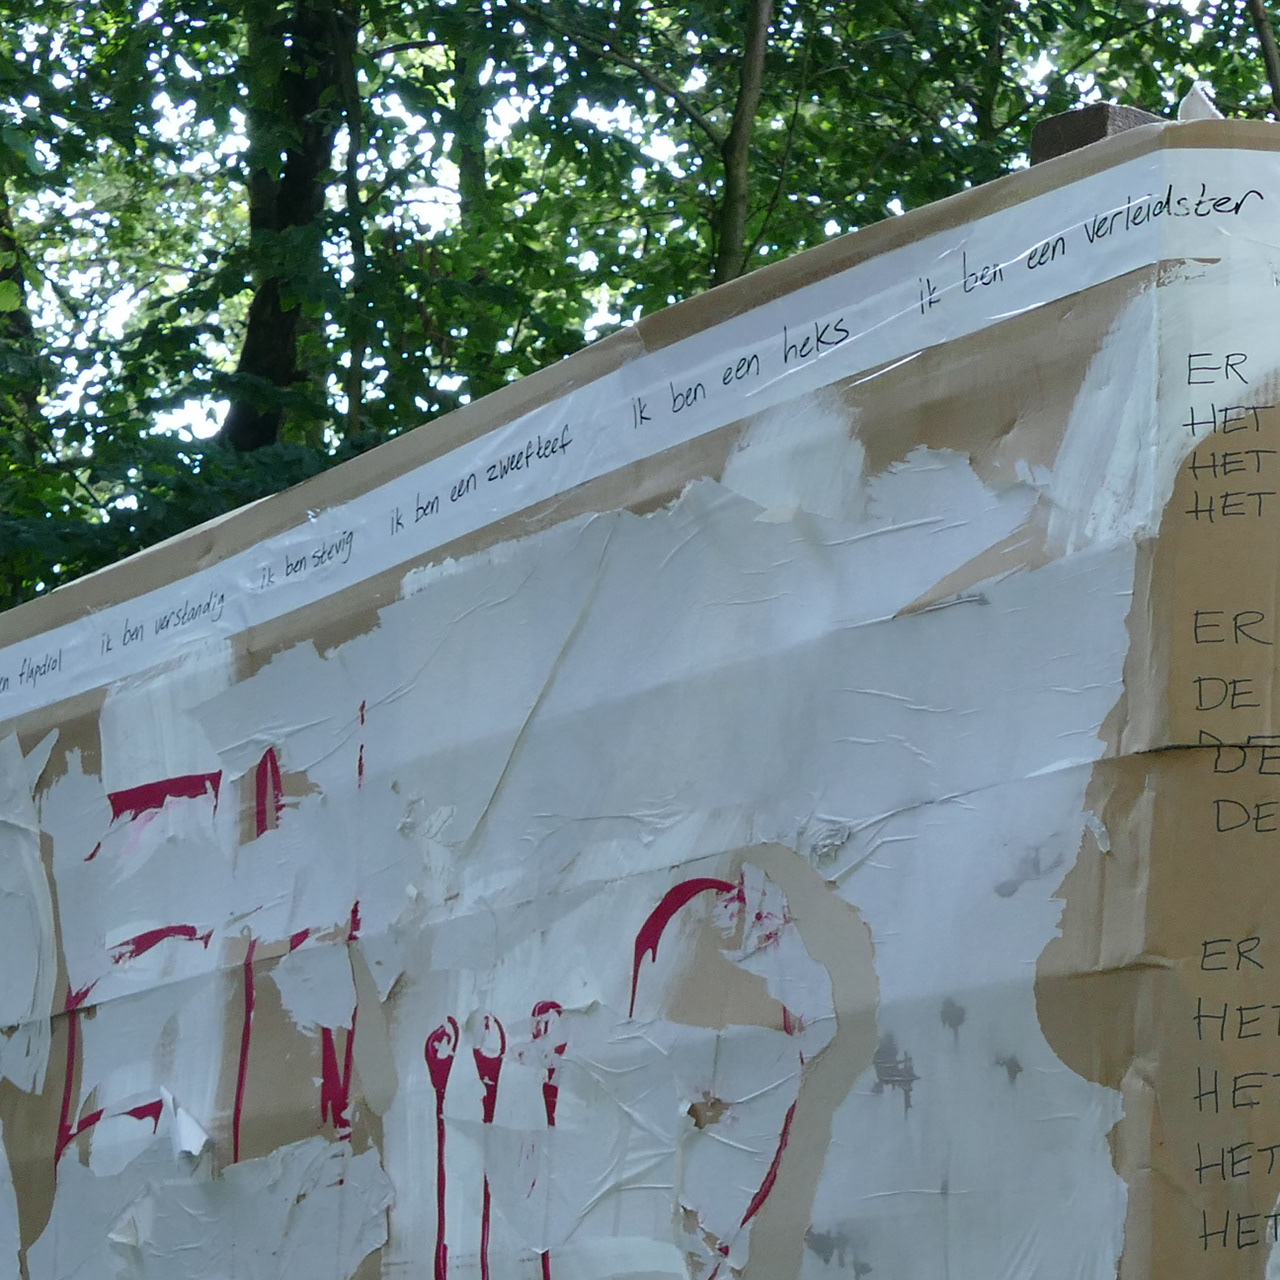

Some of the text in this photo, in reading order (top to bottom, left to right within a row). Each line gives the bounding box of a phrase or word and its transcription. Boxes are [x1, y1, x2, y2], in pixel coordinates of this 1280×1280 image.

[1187, 352, 1249, 386] ER
[19, 648, 63, 690] flapdrol
[100, 631, 113, 657] ik
[123, 619, 144, 646] ben
[155, 591, 226, 638] verstandig
[261, 567, 277, 590] ik
[286, 554, 308, 578] ben
[314, 530, 355, 570] stevig
[389, 508, 405, 536] ik
[414, 492, 440, 523] ben
[450, 471, 477, 503] een
[486, 424, 574, 483] zweefteef
[632, 398, 652, 429] ik
[671, 373, 706, 414] ben
[722, 355, 760, 385] een
[783, 316, 852, 366] heks
[919, 276, 942, 315] ik
[962, 250, 1005, 294] ben
[1026, 236, 1066, 270] een
[1084, 183, 1265, 244] verleidster
[1182, 403, 1275, 437] HET
[1188, 450, 1278, 481] HET
[1185, 490, 1278, 523] HET
[1193, 610, 1274, 645] ER
[1193, 676, 1261, 711] DE
[1213, 799, 1280, 833] DE
[1201, 936, 1264, 972] ER
